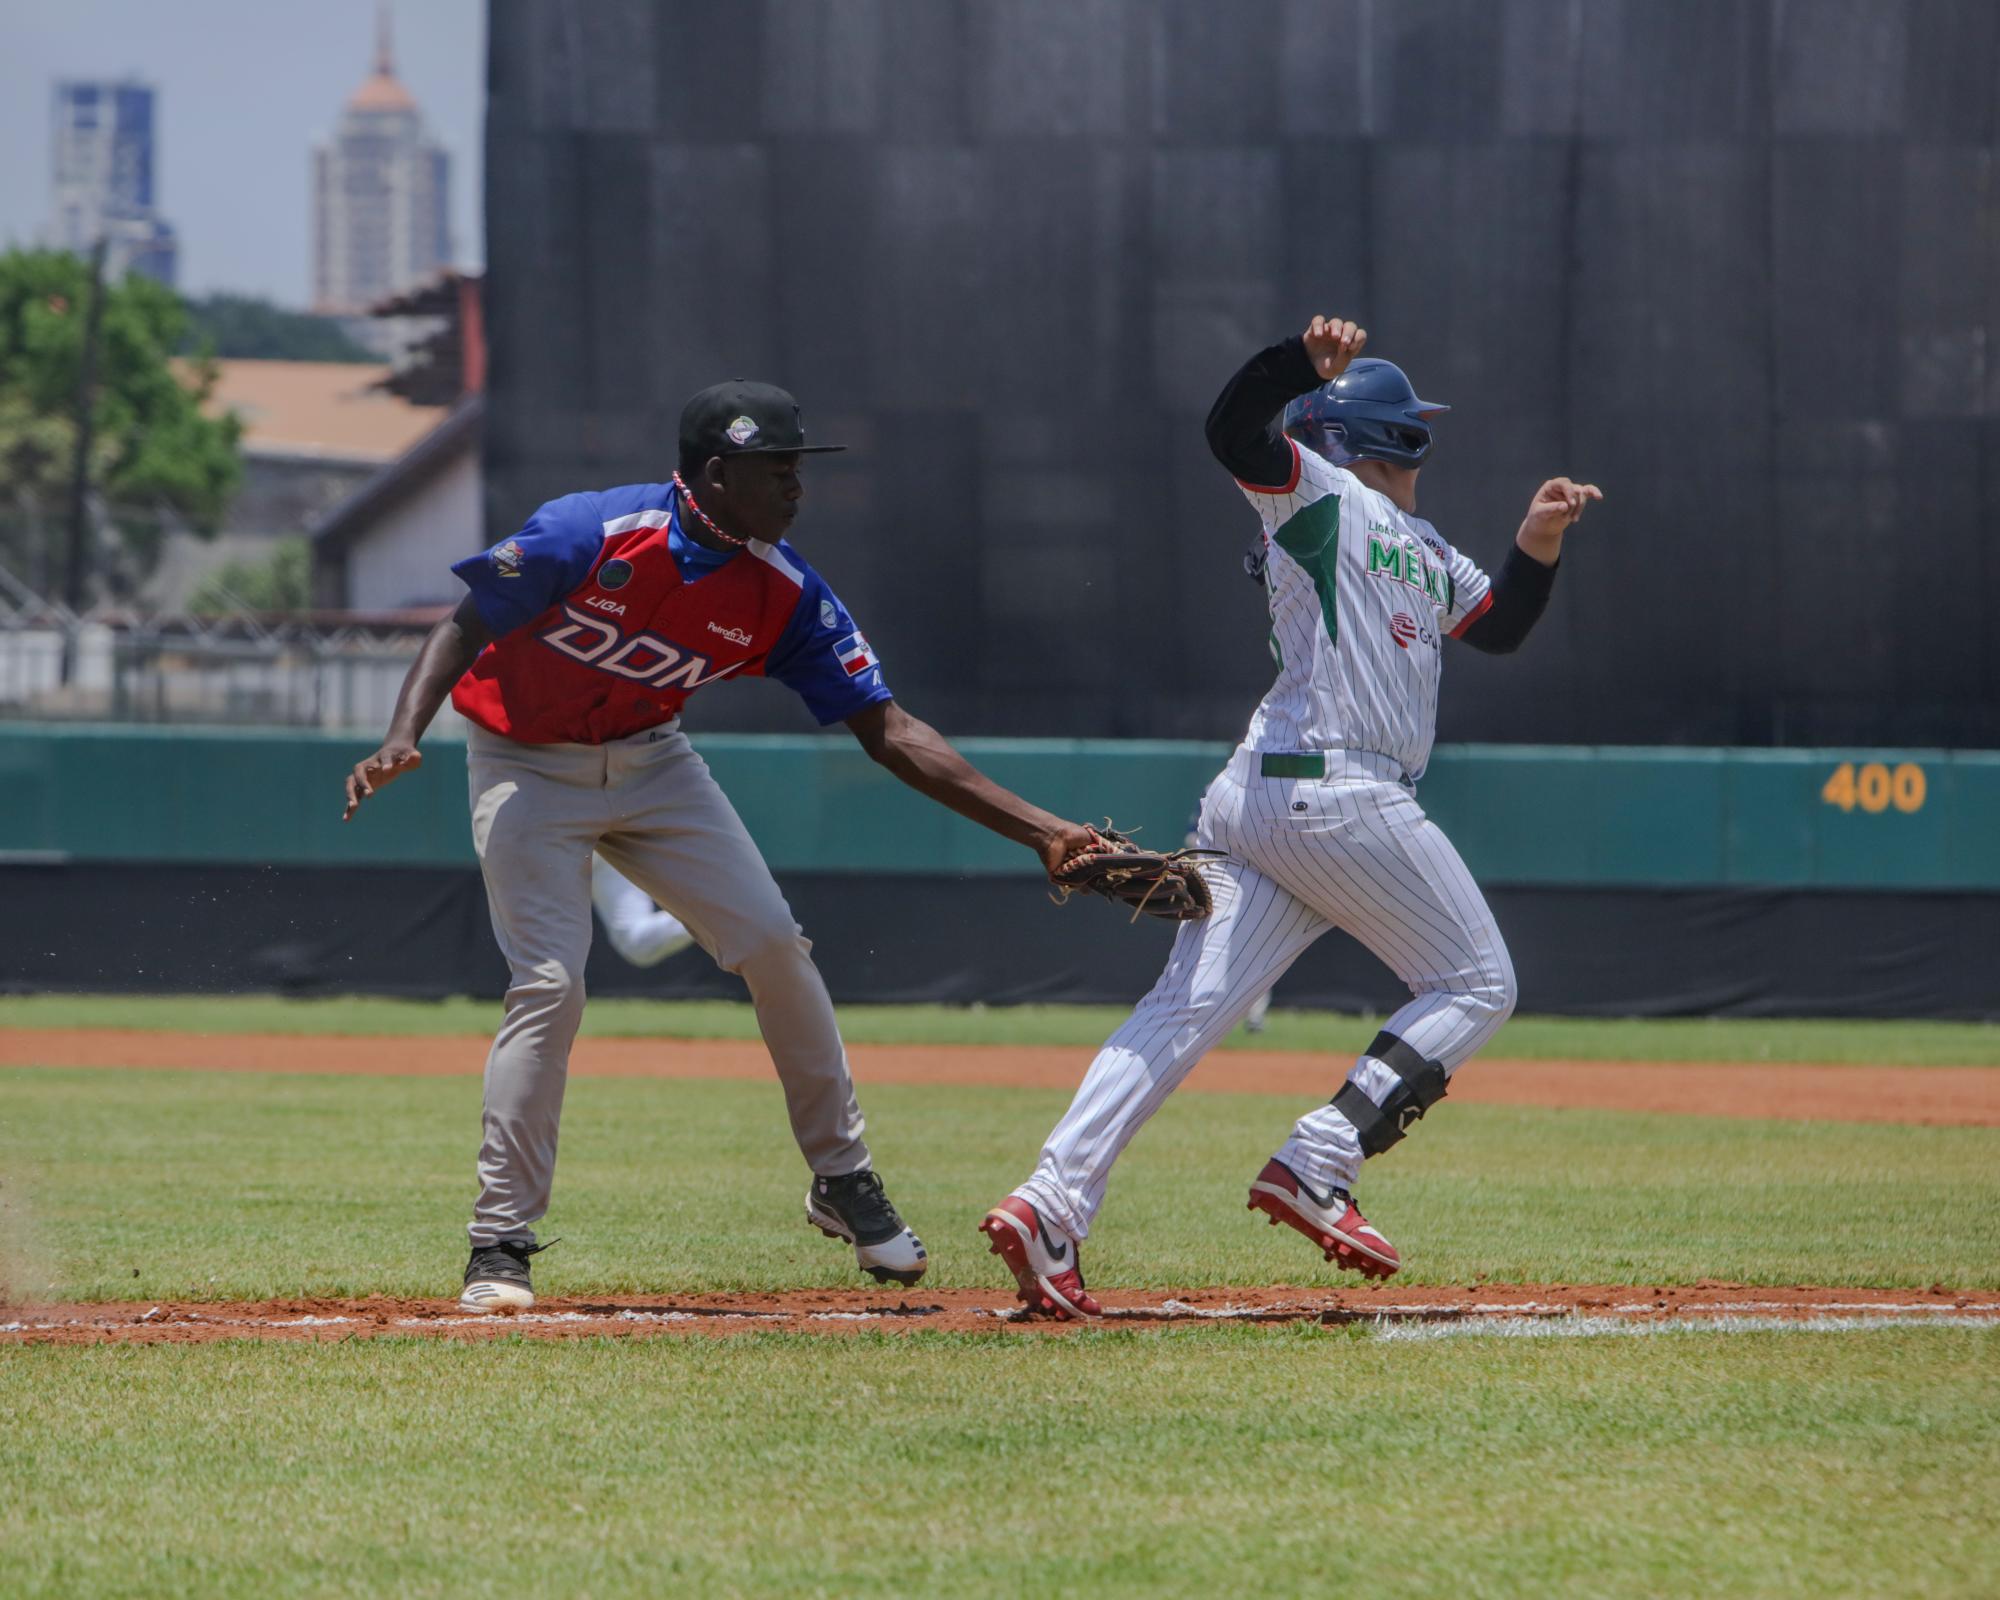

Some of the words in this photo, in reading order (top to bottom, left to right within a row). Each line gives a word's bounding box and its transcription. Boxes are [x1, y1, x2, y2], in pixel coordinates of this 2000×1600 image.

[1368, 520, 1390, 535] LIGA
[584, 596, 627, 616] LIGA
[1821, 761, 1927, 814] 400
